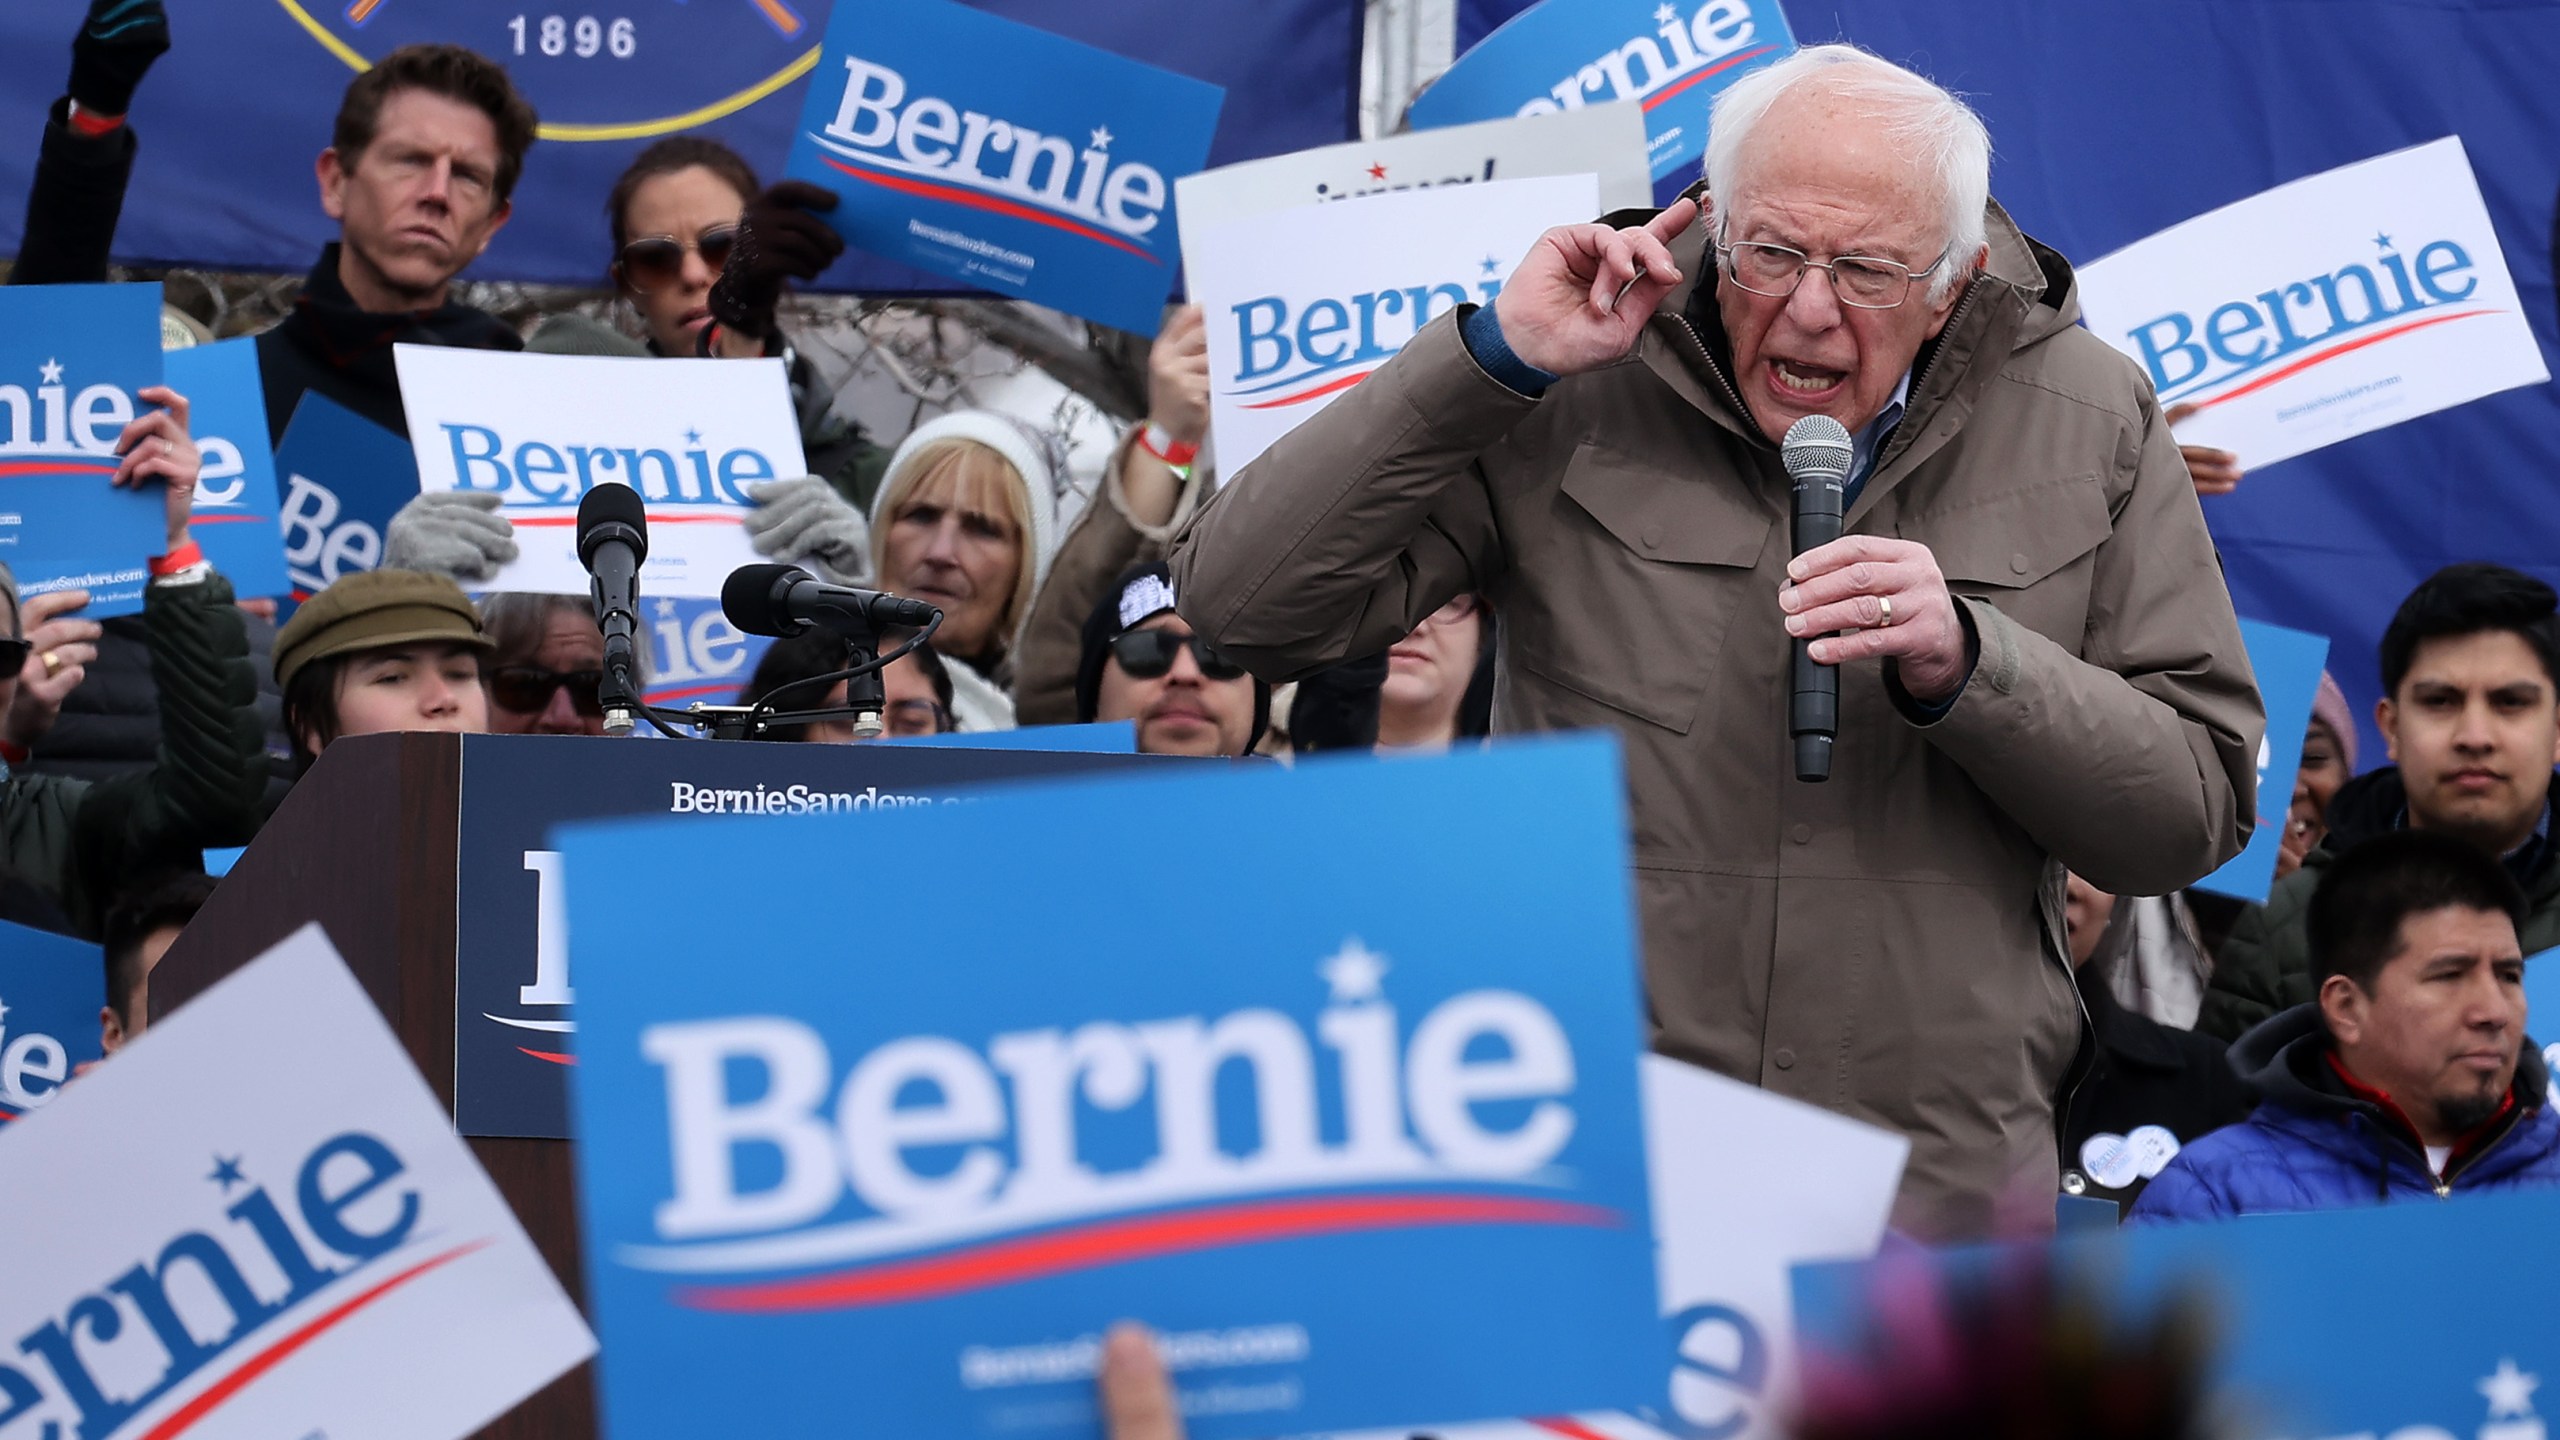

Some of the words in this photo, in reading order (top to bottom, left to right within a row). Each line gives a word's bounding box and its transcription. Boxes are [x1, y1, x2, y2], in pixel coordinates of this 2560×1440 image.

[507, 14, 636, 58] 1896
[1516, 0, 1755, 118] rnie
[824, 54, 1166, 238] Bernie
[2127, 230, 2478, 393] Bernie
[440, 423, 775, 507] Bernie
[640, 938, 1577, 1243] Bernie
